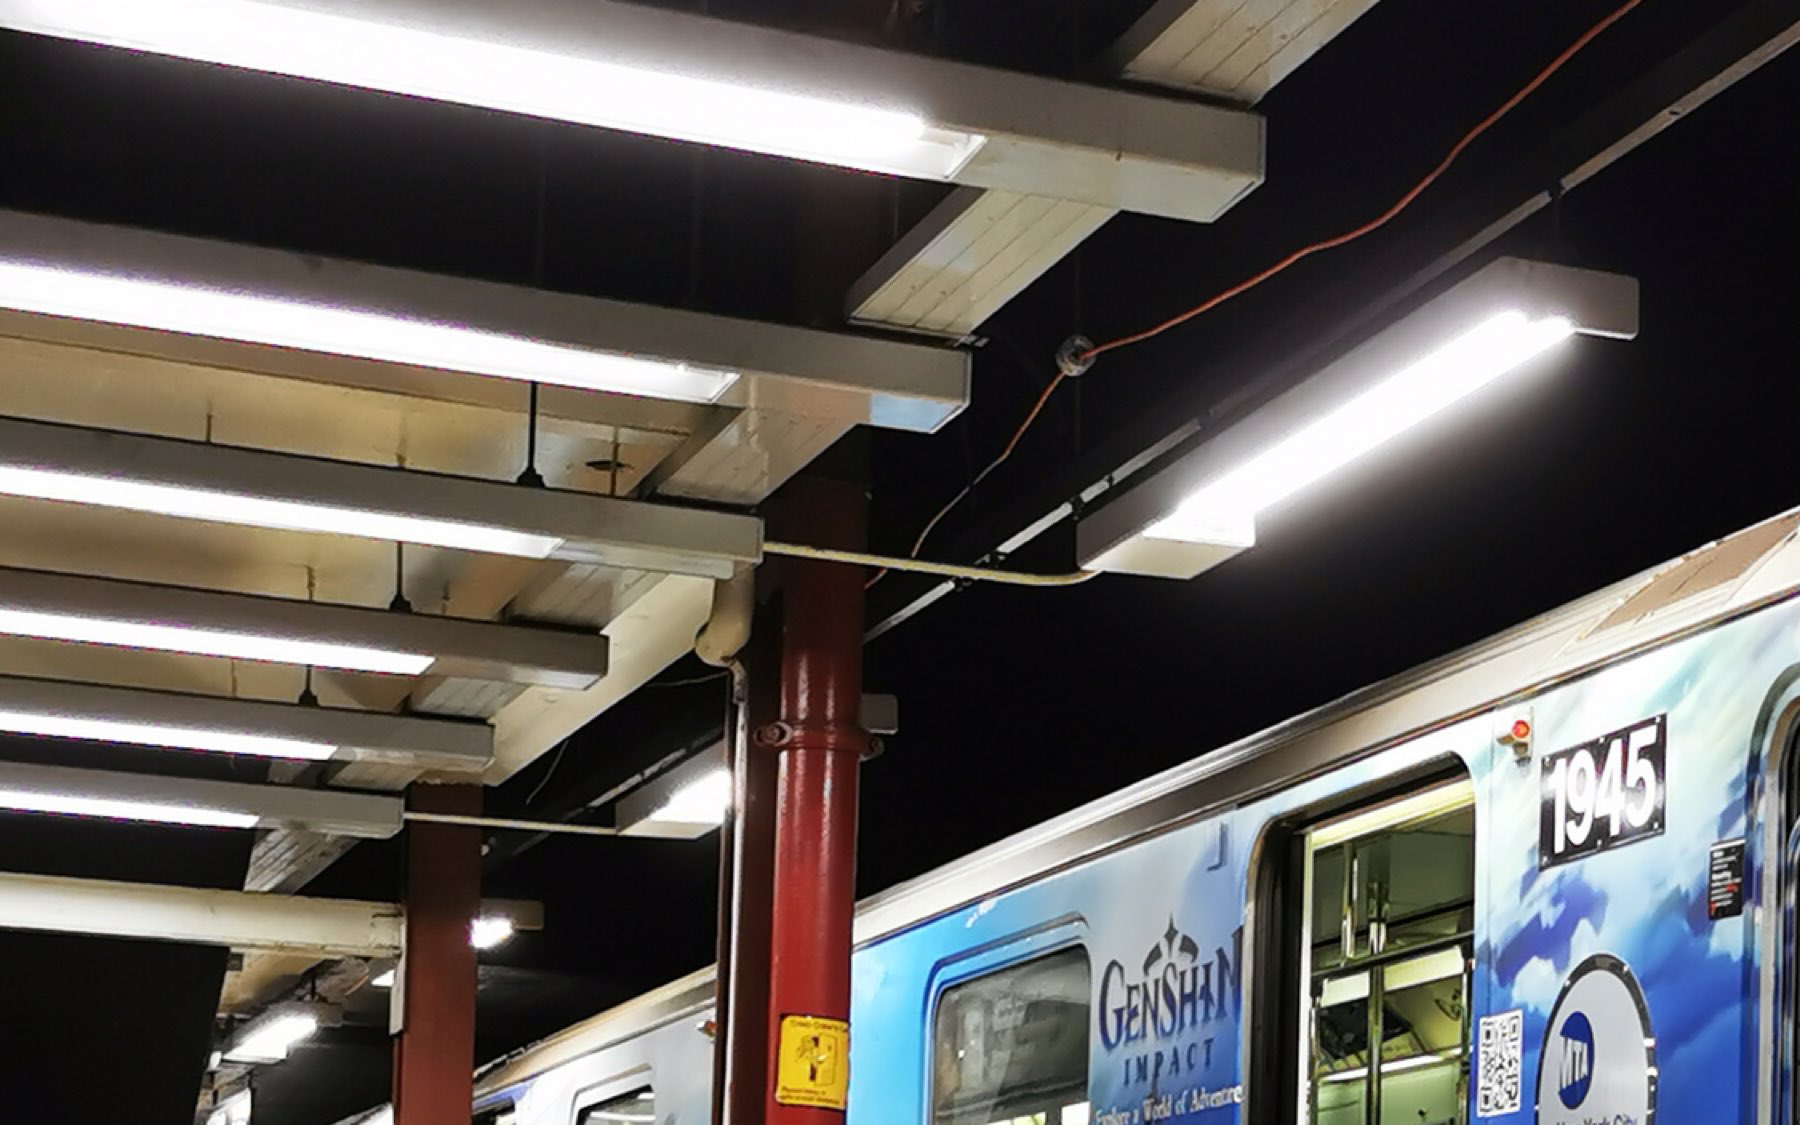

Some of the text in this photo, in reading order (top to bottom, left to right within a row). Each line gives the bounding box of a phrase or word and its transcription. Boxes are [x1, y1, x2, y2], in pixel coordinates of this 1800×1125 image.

[1548, 724, 1657, 853] 1945
[1100, 925, 1243, 1050] GENSHIN
[1124, 1038, 1215, 1087] IMPACT
[1561, 1035, 1588, 1089] MTA
[1143, 1094, 1172, 1121] World
[1175, 1090, 1188, 1115] of
